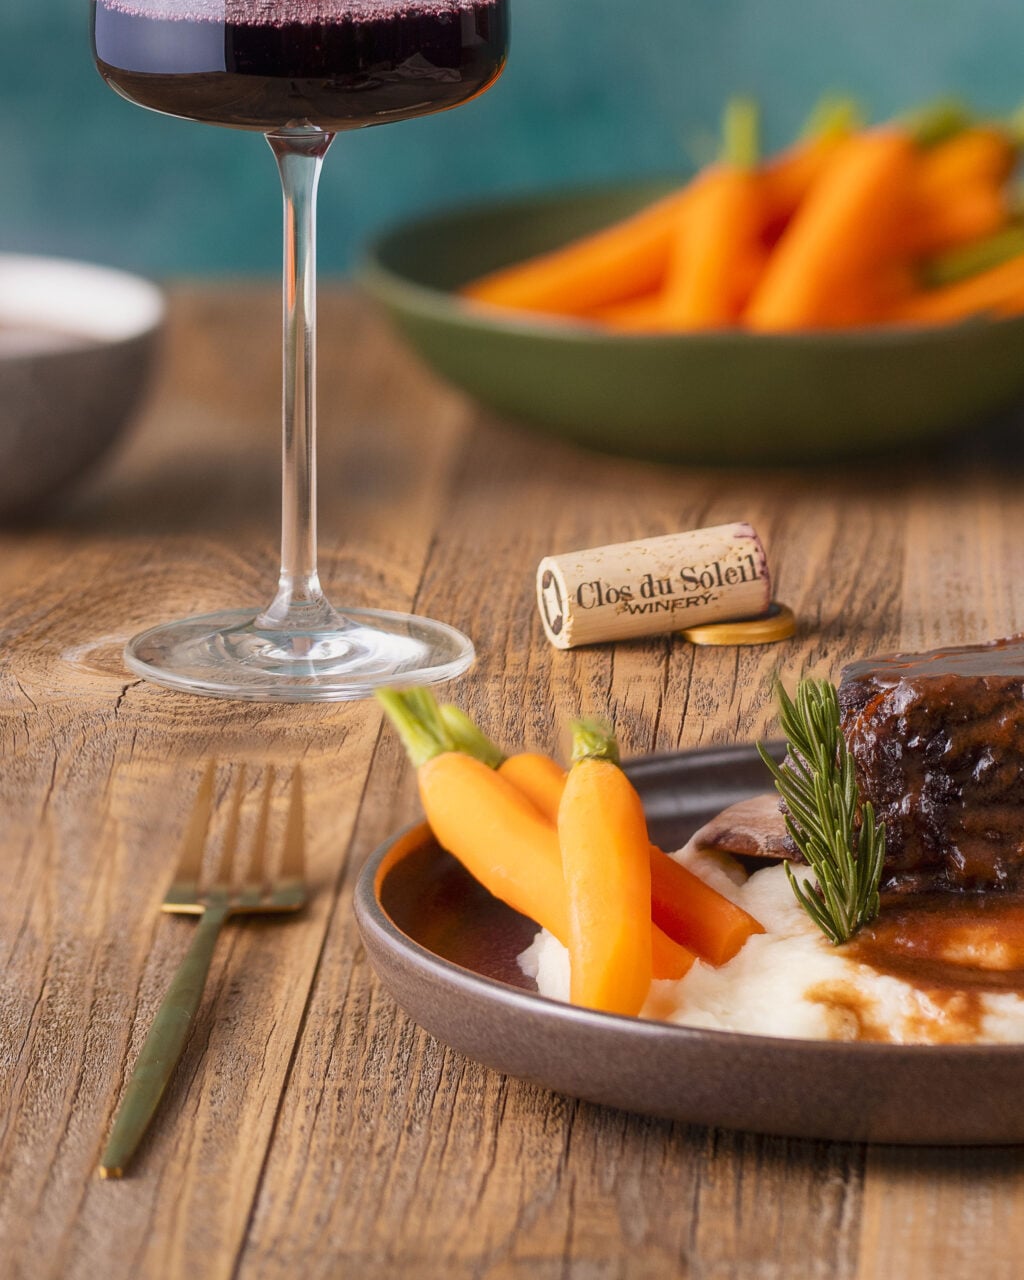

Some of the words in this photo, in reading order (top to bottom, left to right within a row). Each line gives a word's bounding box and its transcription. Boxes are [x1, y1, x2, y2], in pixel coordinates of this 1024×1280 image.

[576, 578, 633, 610] Clos
[639, 573, 676, 600] du
[679, 553, 761, 593] Soleil
